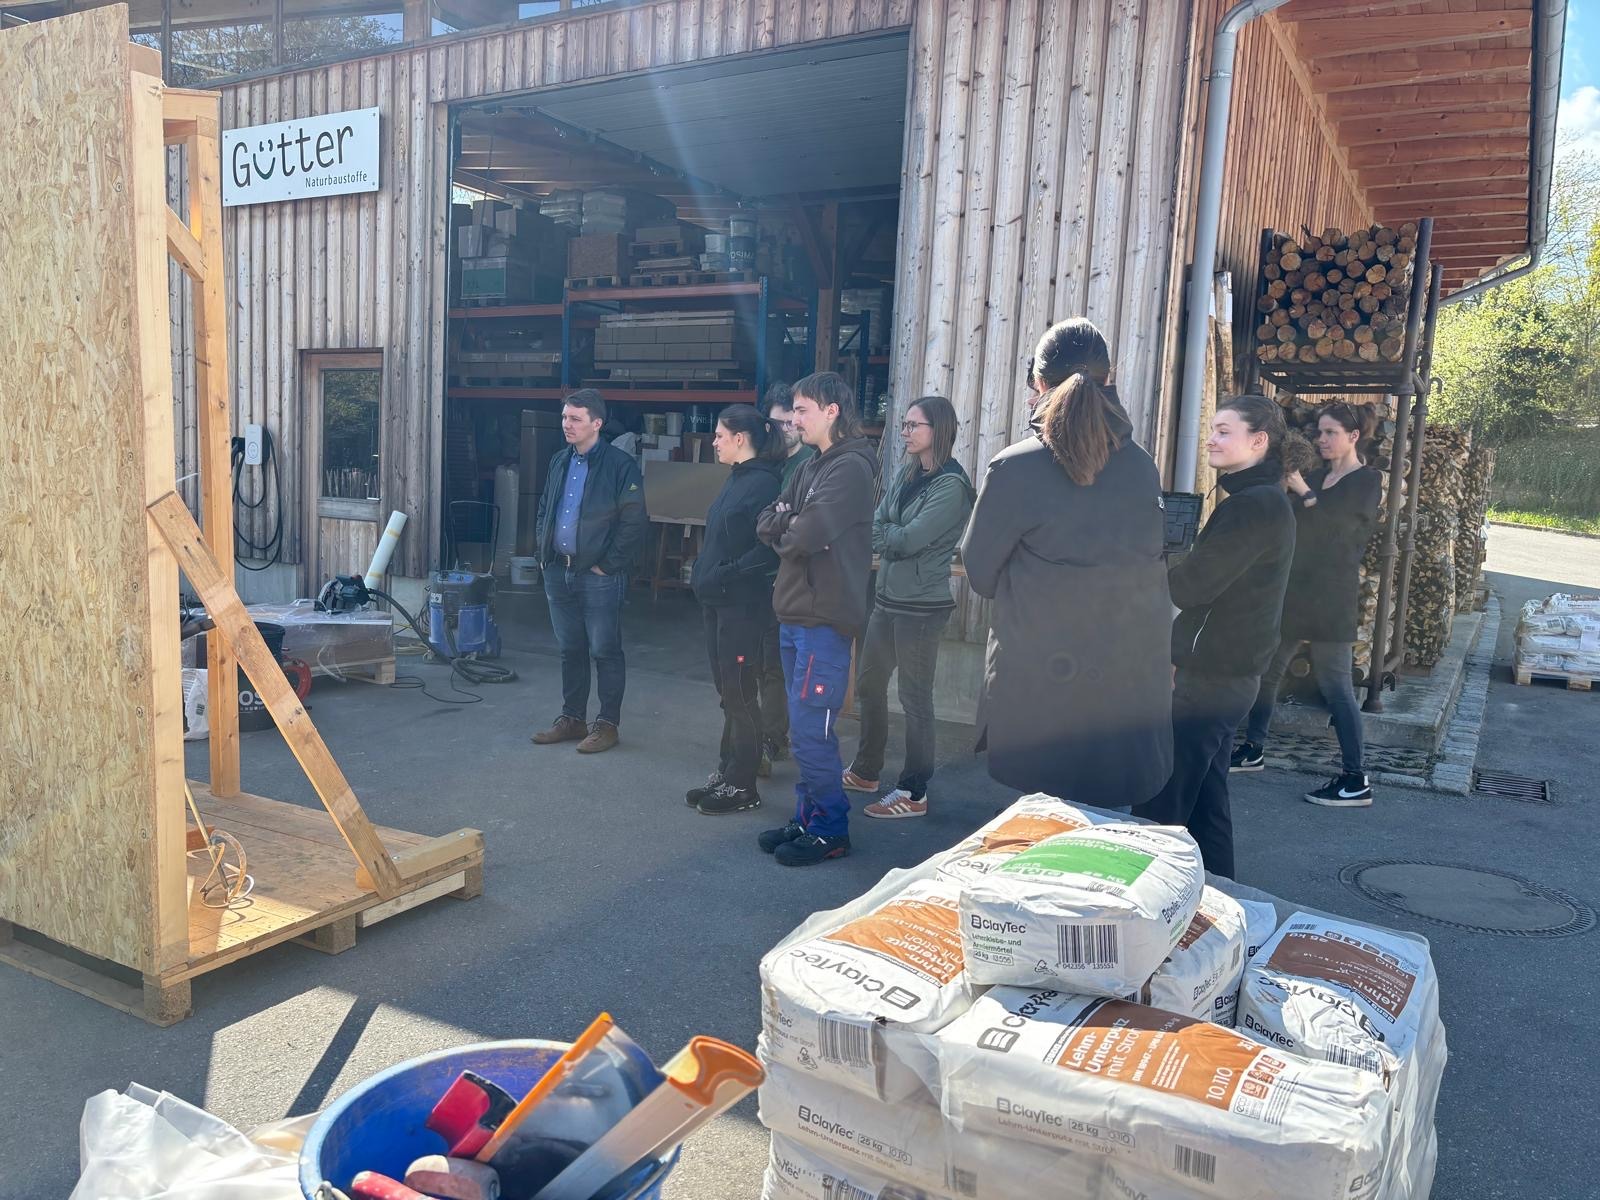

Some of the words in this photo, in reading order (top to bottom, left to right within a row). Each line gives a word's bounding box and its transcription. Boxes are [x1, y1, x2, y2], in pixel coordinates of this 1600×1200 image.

[232, 125, 354, 188] Gütter
[305, 170, 368, 188] Naturbaustoffe
[982, 919, 1027, 934] ClayTec
[885, 936, 956, 972] Unterputz
[904, 932, 938, 953] Stroh
[790, 949, 885, 992] ClayTec
[1085, 1018, 1130, 1073] Unterputz
[1115, 1028, 1141, 1054] Stroh
[1254, 1022, 1294, 1048] ClayTec
[1065, 1032, 1098, 1068] Lehm-
[1106, 1055, 1127, 1078] mit
[1206, 1067, 1233, 1100] 10.110
[811, 1113, 853, 1140] ClayTec
[1012, 1103, 1063, 1127] ClayTec
[798, 1123, 860, 1155] Lehm-Unterputz
[1071, 1121, 1084, 1132] 25
[1086, 1125, 1099, 1137] kg
[860, 1136, 871, 1146] 25
[872, 1140, 883, 1152] kg
